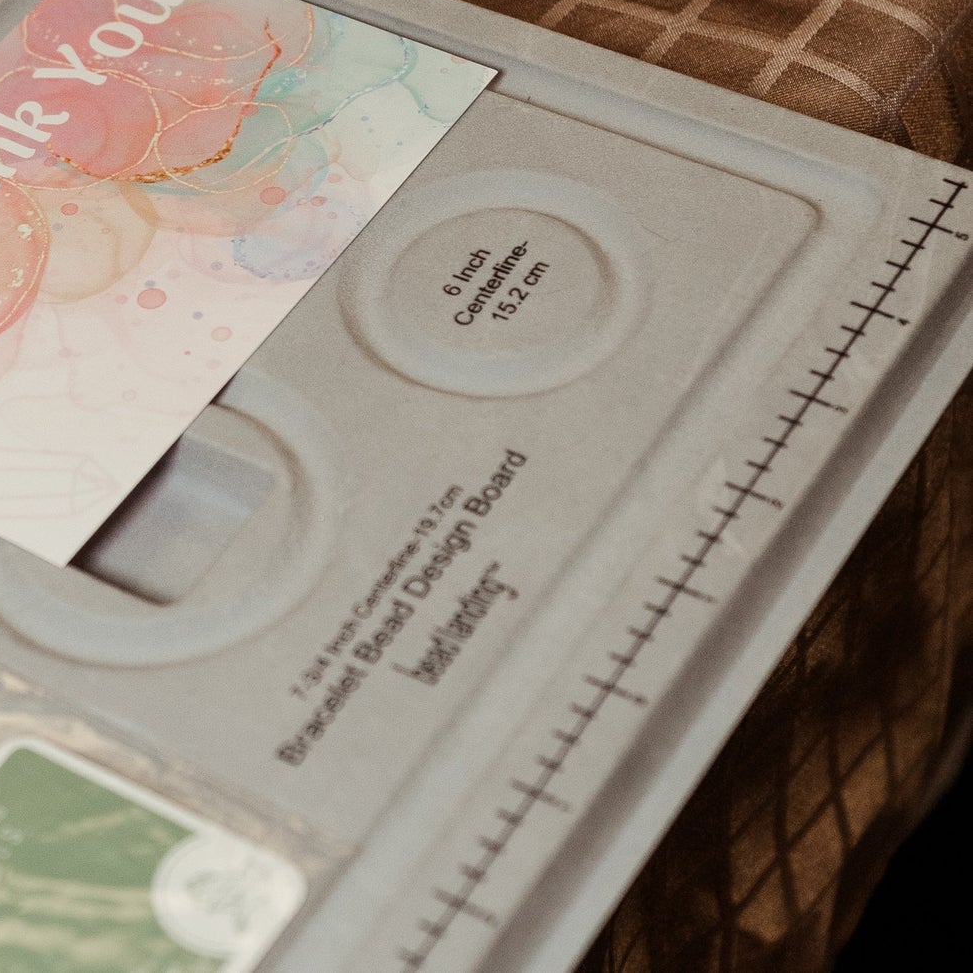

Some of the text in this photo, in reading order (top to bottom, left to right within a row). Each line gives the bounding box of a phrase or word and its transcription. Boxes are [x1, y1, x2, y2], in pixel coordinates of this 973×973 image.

[953, 230, 970, 242] 5
[442, 249, 491, 296] 6 Inch
[491, 261, 550, 321] 15.2 cm
[275, 448, 527, 766] Bracelet Bead Design Board
